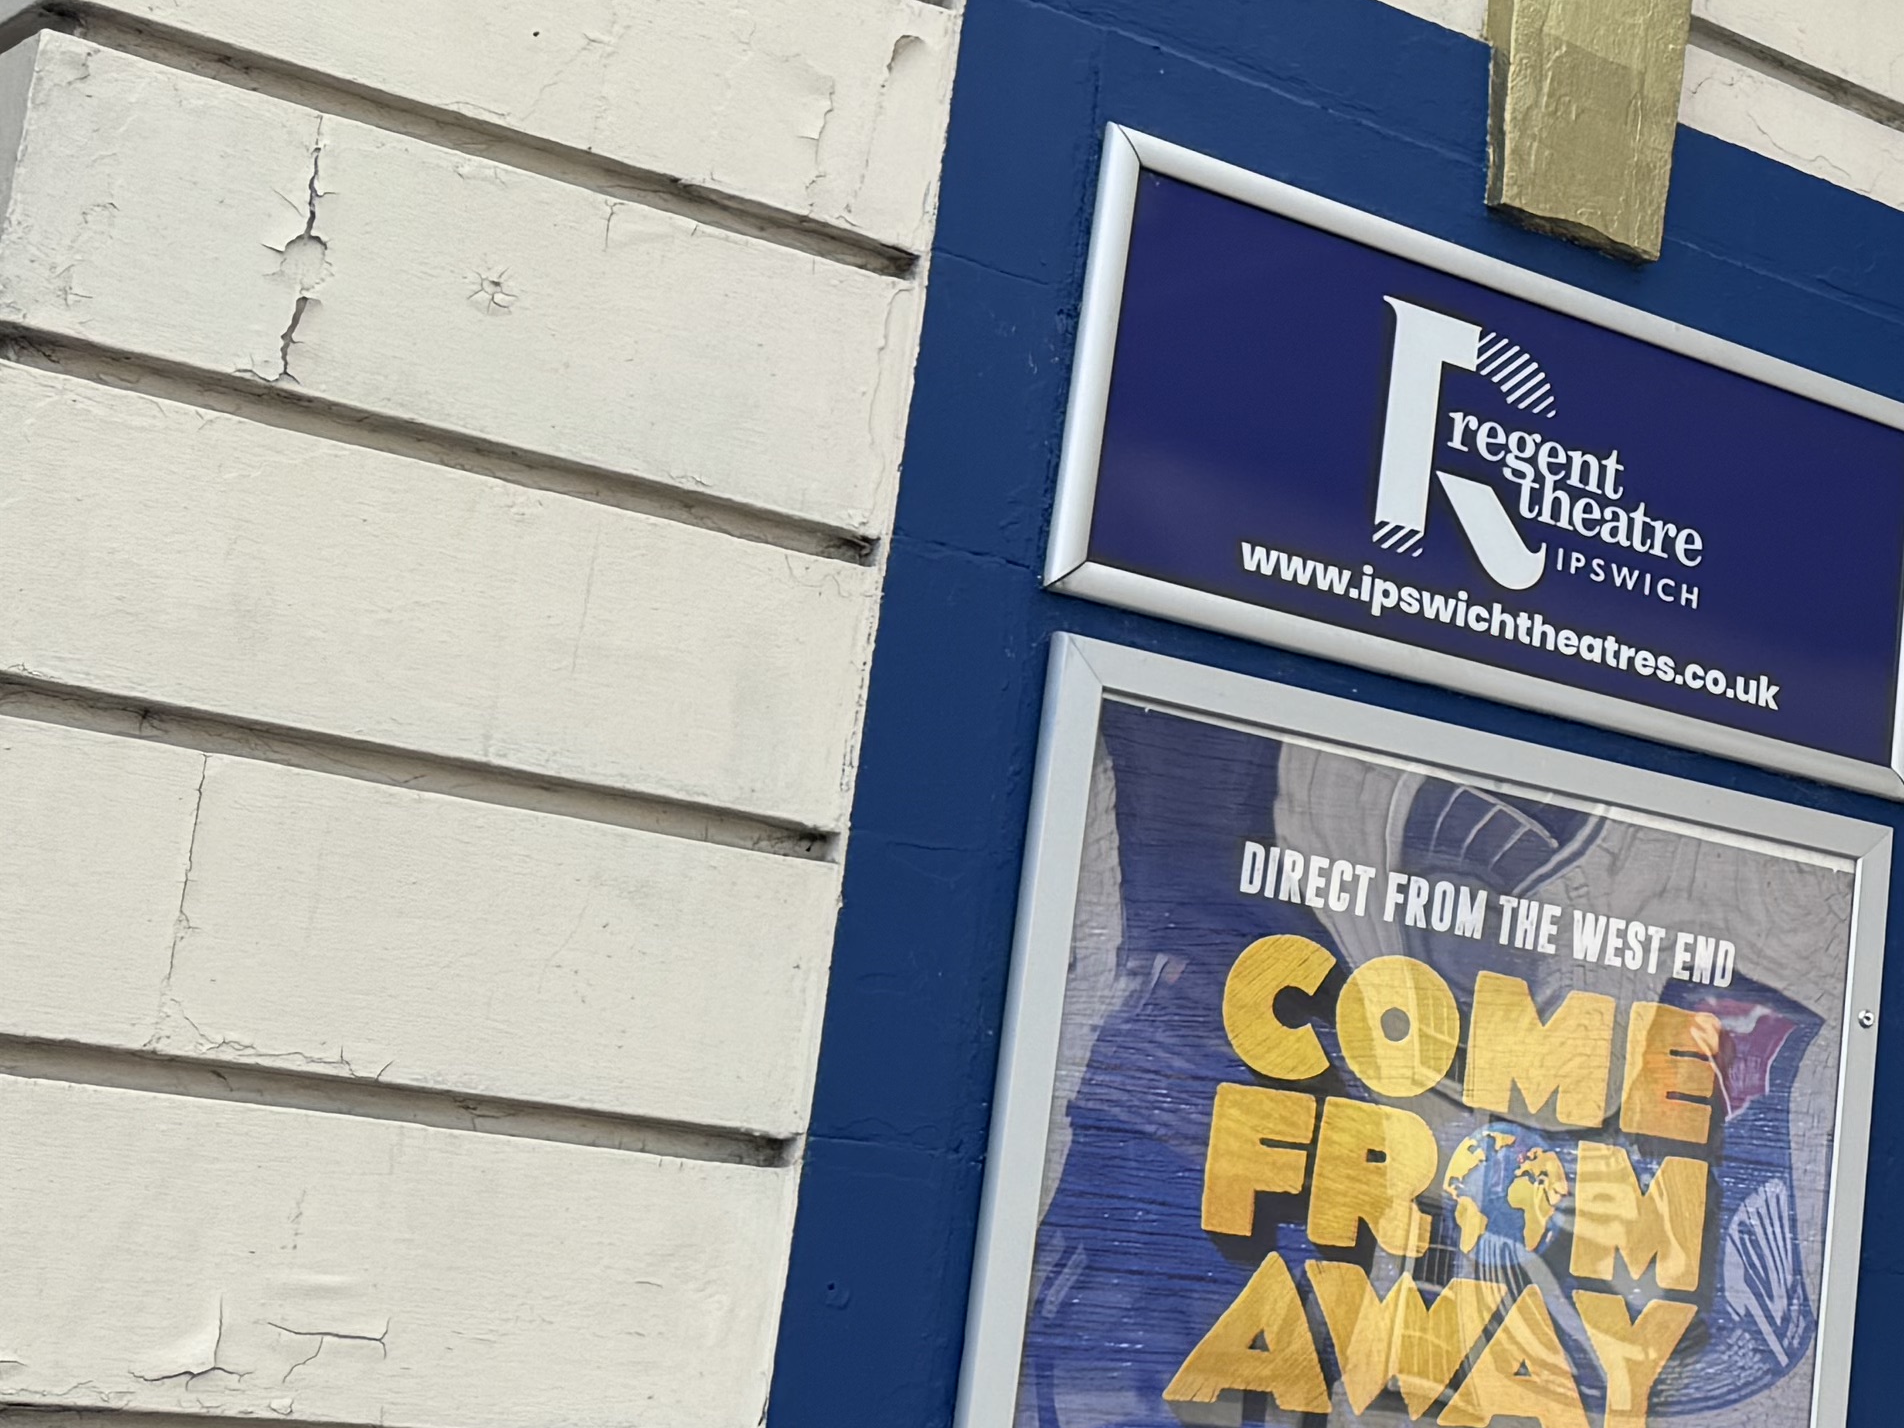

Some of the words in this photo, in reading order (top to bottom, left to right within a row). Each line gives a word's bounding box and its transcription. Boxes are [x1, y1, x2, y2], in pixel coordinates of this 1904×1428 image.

[1447, 410, 1624, 500] regent
[1518, 467, 1703, 567] theatre
[1241, 540, 1780, 712] www.ipswichtheatres.co.uk
[1556, 548, 1700, 610] IPSWICH
[1239, 841, 1376, 917] DIRECT
[1384, 871, 1487, 940] FROM
[1499, 895, 1562, 954] THE
[1572, 910, 1663, 975] WEST
[1672, 933, 1737, 988] END
[1222, 934, 1721, 1145] COME
